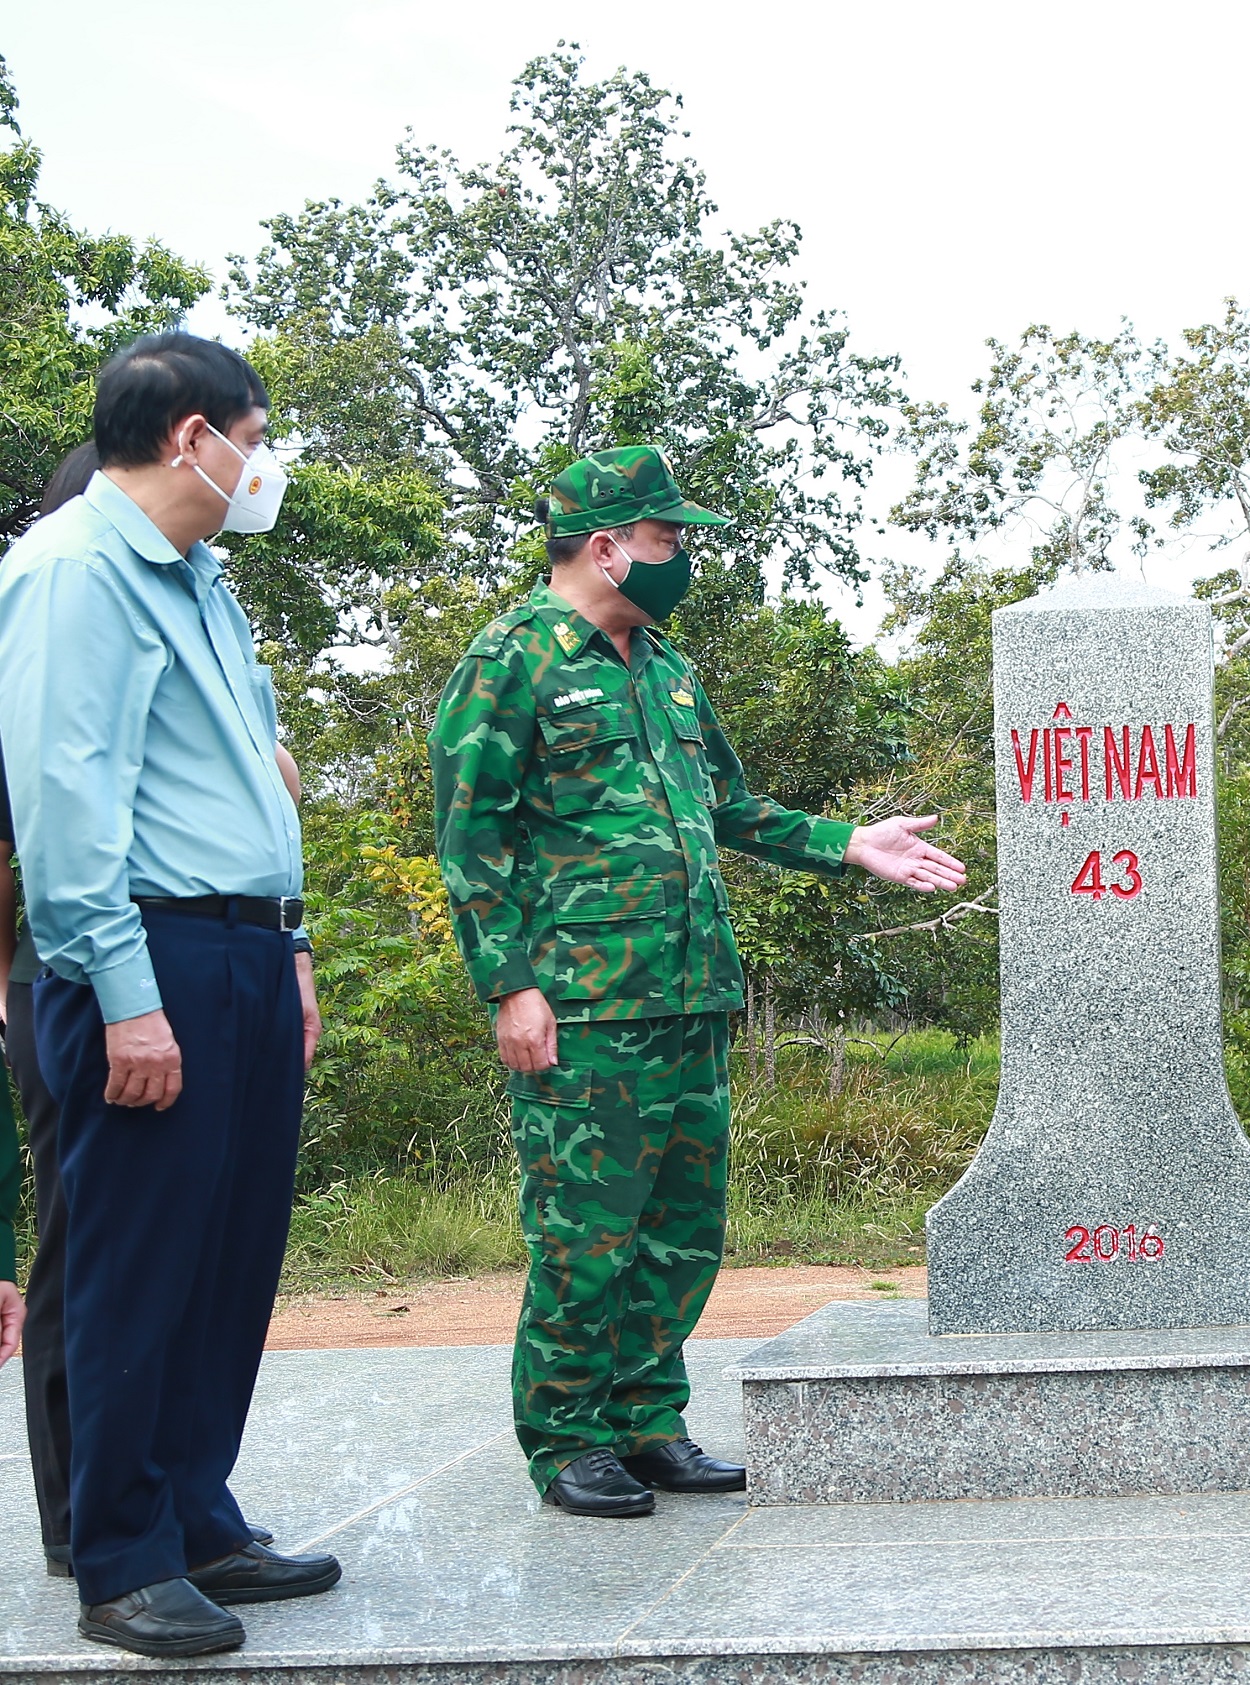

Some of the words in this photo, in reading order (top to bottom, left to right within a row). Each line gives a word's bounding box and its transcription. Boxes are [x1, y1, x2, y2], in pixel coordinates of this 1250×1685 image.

[1010, 702, 1093, 827] VIỆT
[1104, 723, 1197, 802] NAM
[1070, 849, 1143, 901] 43
[1064, 1223, 1164, 1263] 2016
